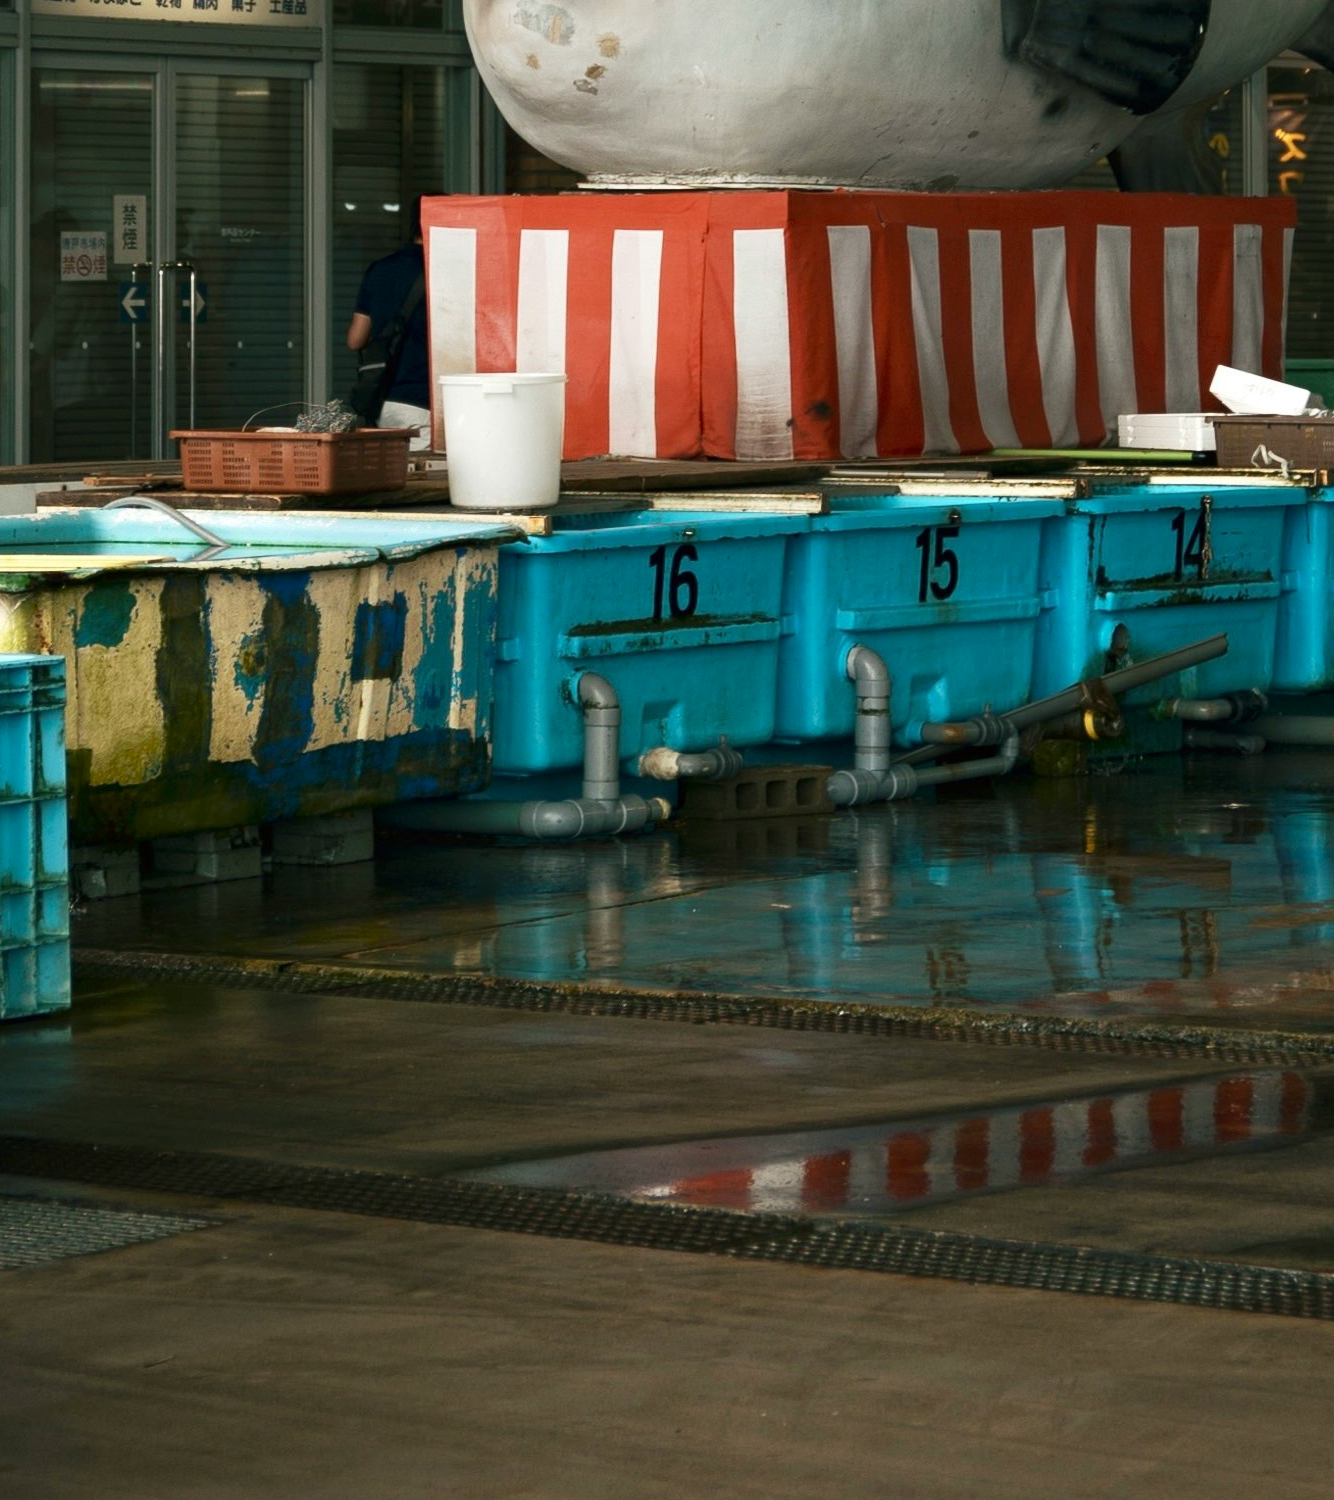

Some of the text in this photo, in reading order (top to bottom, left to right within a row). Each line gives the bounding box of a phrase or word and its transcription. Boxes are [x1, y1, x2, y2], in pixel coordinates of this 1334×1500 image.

[122, 203, 138, 251] 禁煙
[914, 526, 960, 602] 15
[1171, 506, 1211, 581] 14
[648, 543, 700, 621] 16
